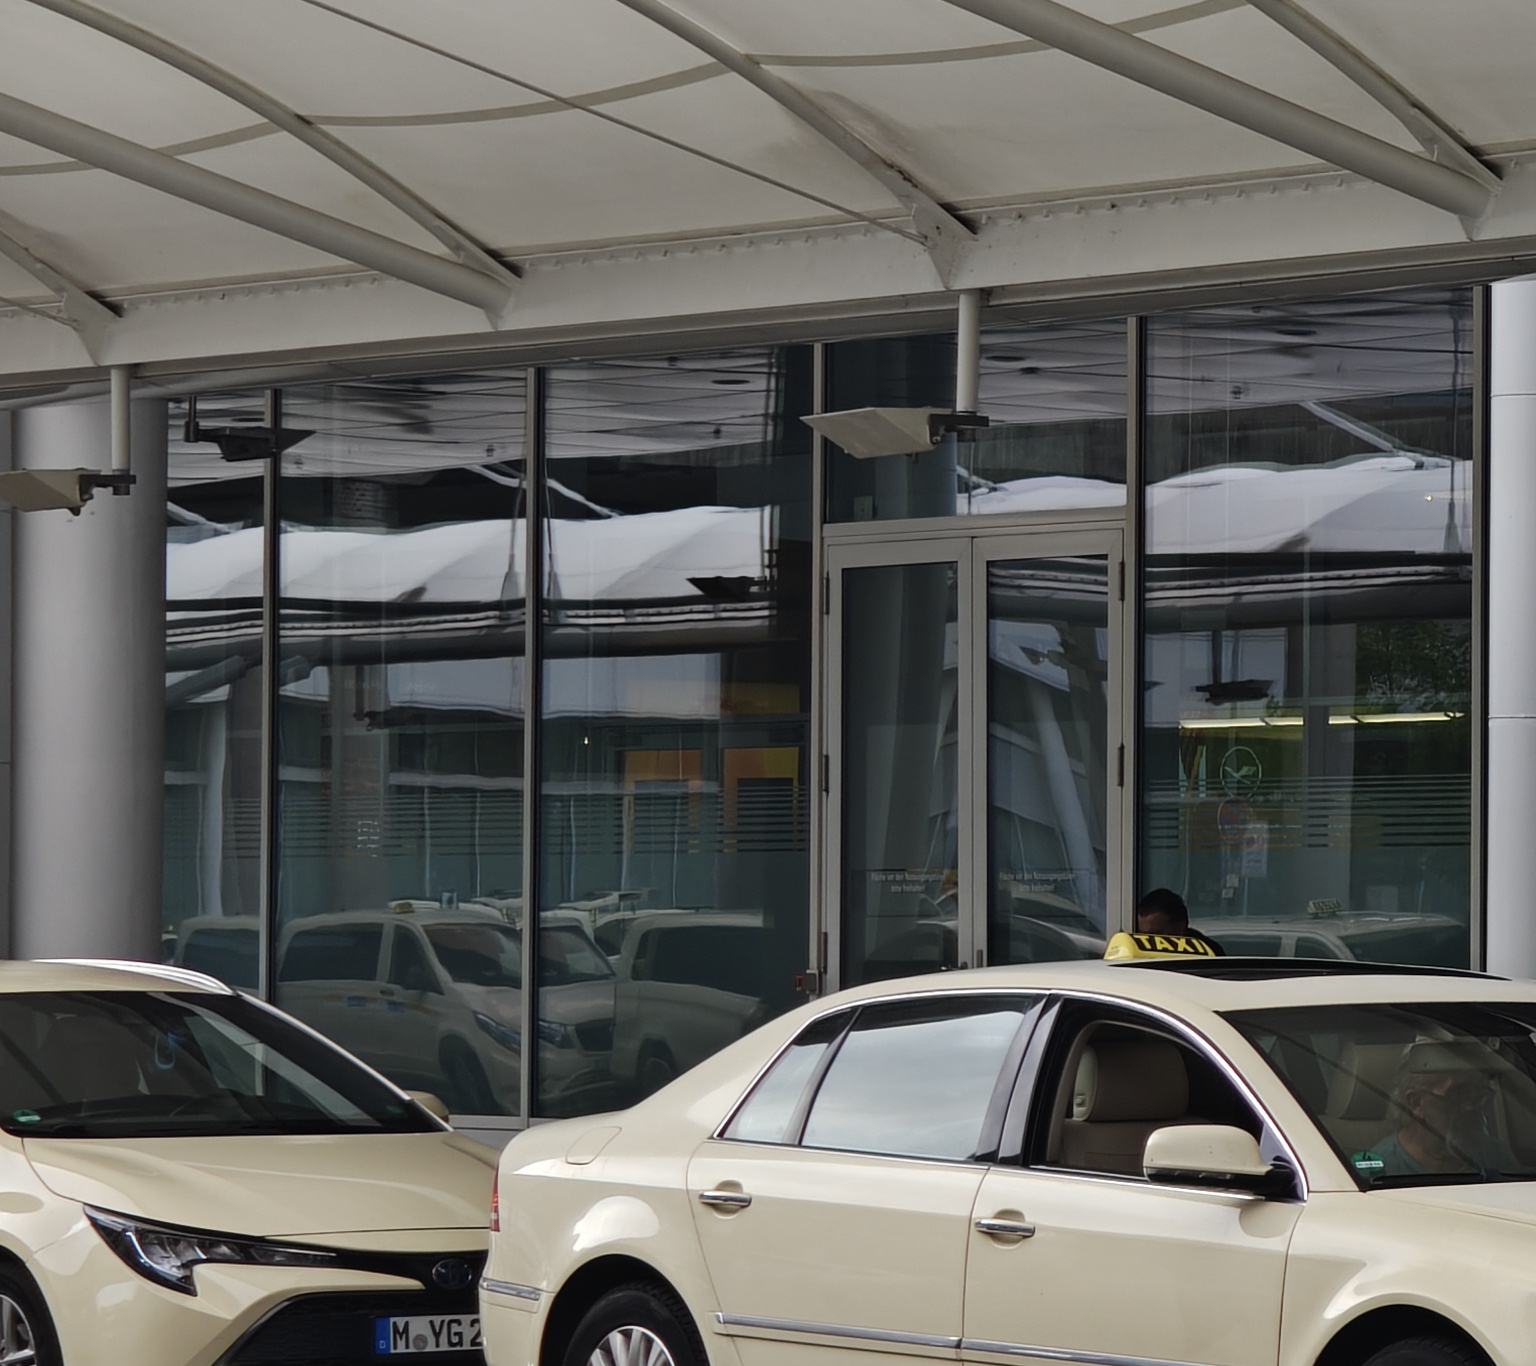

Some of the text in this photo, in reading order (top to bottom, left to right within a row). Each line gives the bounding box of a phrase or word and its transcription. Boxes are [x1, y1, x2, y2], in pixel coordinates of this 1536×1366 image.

[1133, 935, 1205, 953] TAXI
[392, 1320, 409, 1350] M
[429, 1318, 463, 1349] YG
